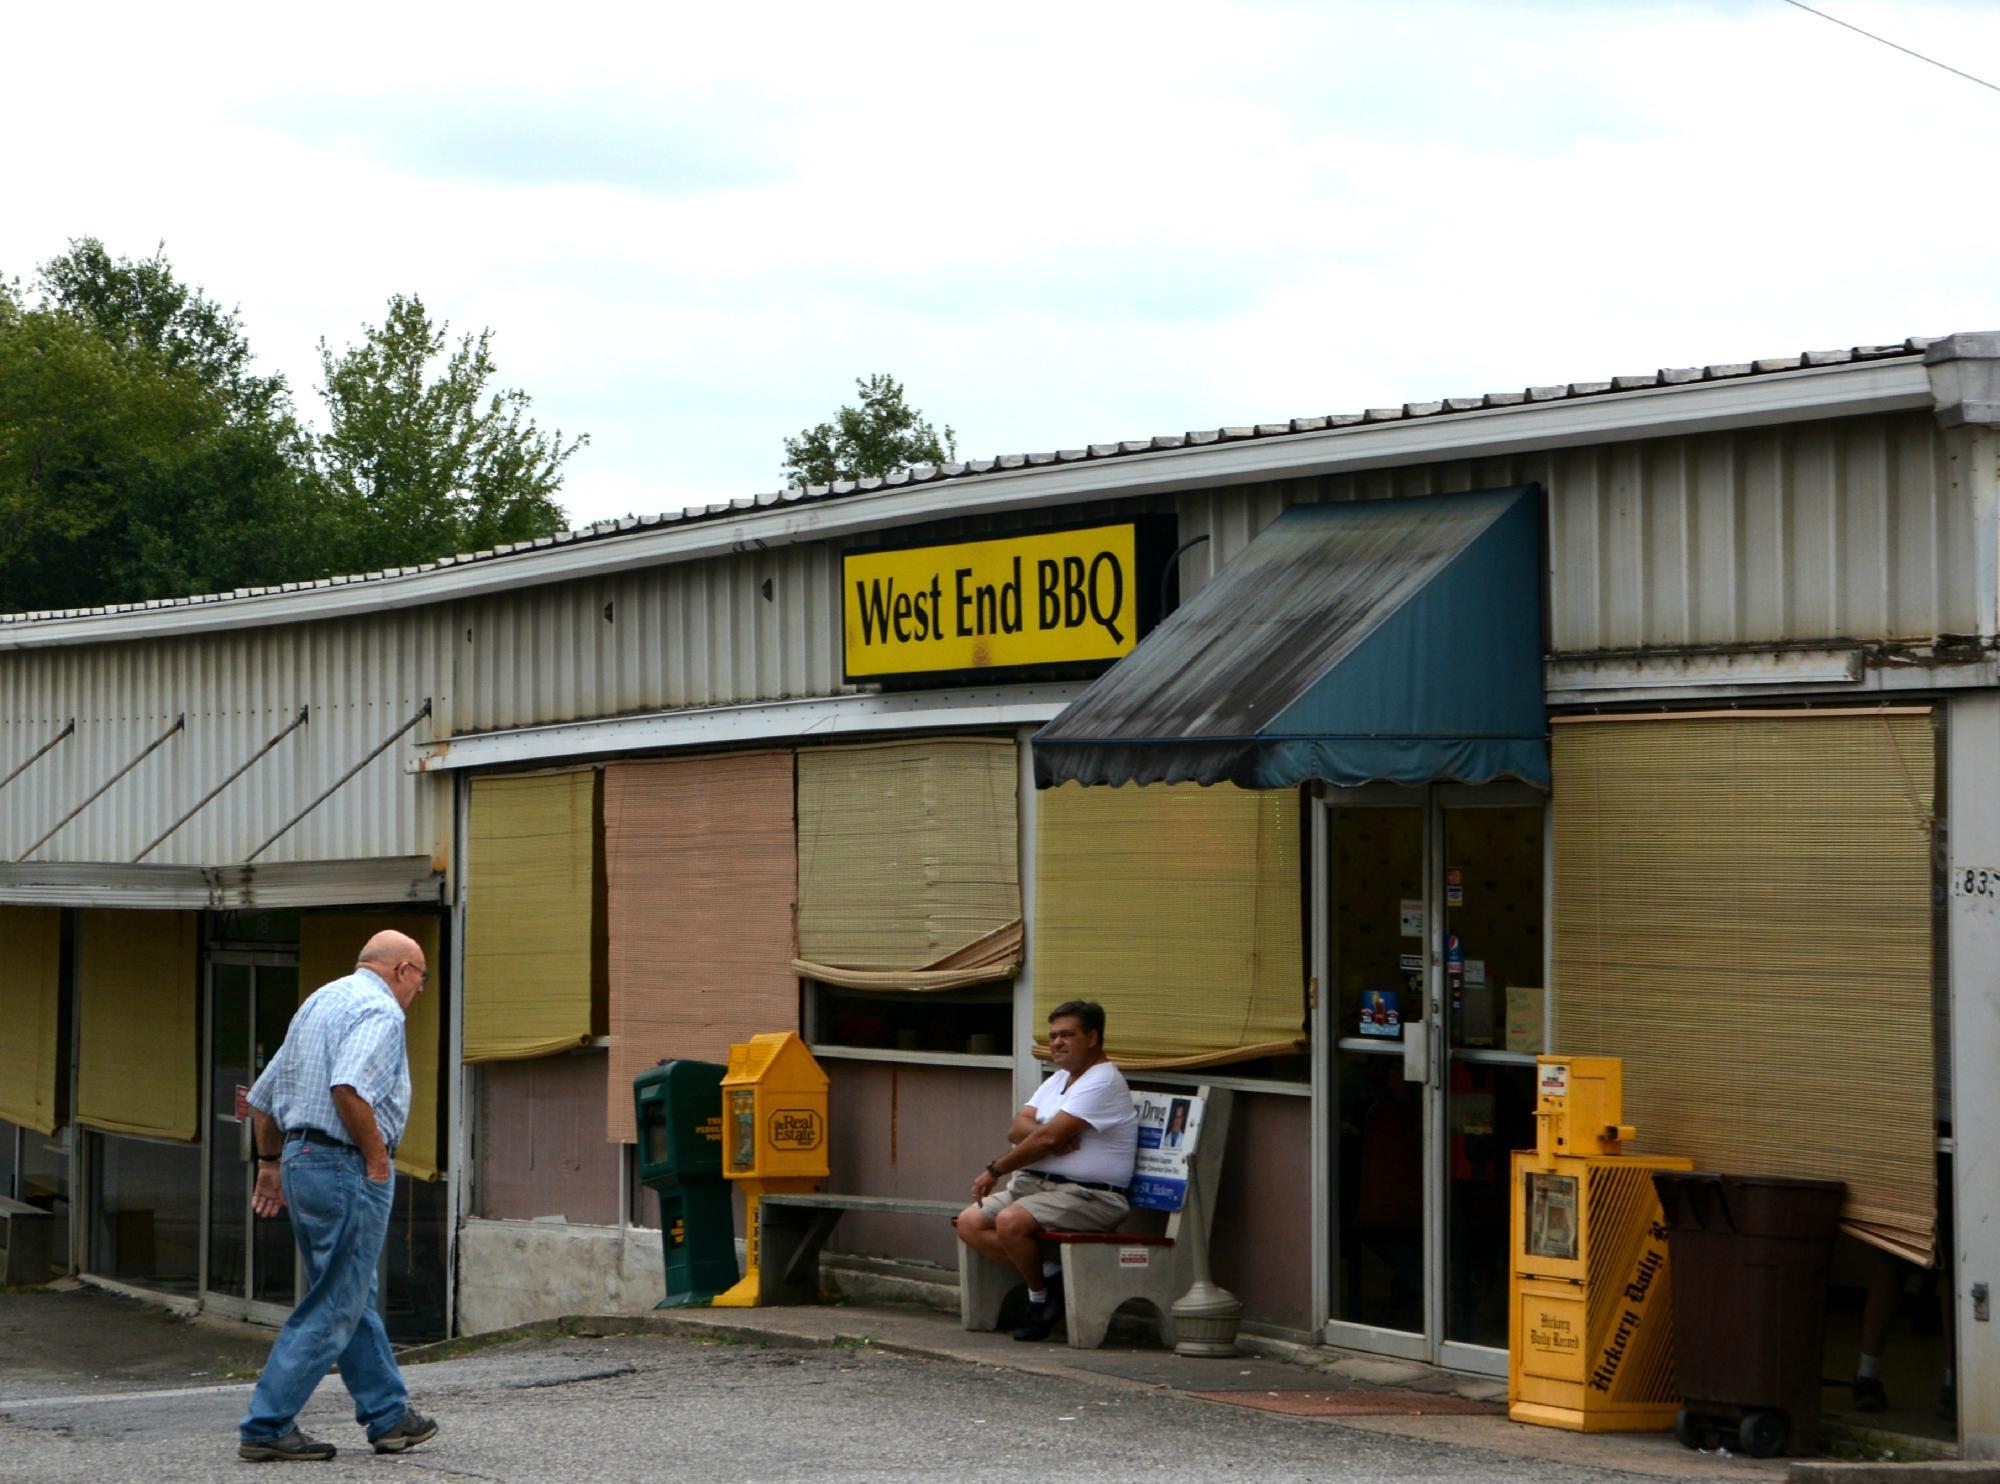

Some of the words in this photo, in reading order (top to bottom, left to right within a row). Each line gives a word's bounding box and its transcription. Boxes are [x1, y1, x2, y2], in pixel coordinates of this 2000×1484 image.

[856, 572, 944, 646] West
[955, 556, 1023, 638] End
[1038, 551, 1124, 646] BBQ
[784, 1114, 813, 1129] Real
[1141, 1100, 1167, 1126] Drug
[775, 1127, 816, 1142] Estate
[1540, 1313, 1570, 1334] Hickory
[1589, 1309, 1640, 1395] Hickory
[1623, 1249, 1663, 1304] Daily
[1530, 1329, 1552, 1349] Daily
[1553, 1331, 1579, 1349] Record
